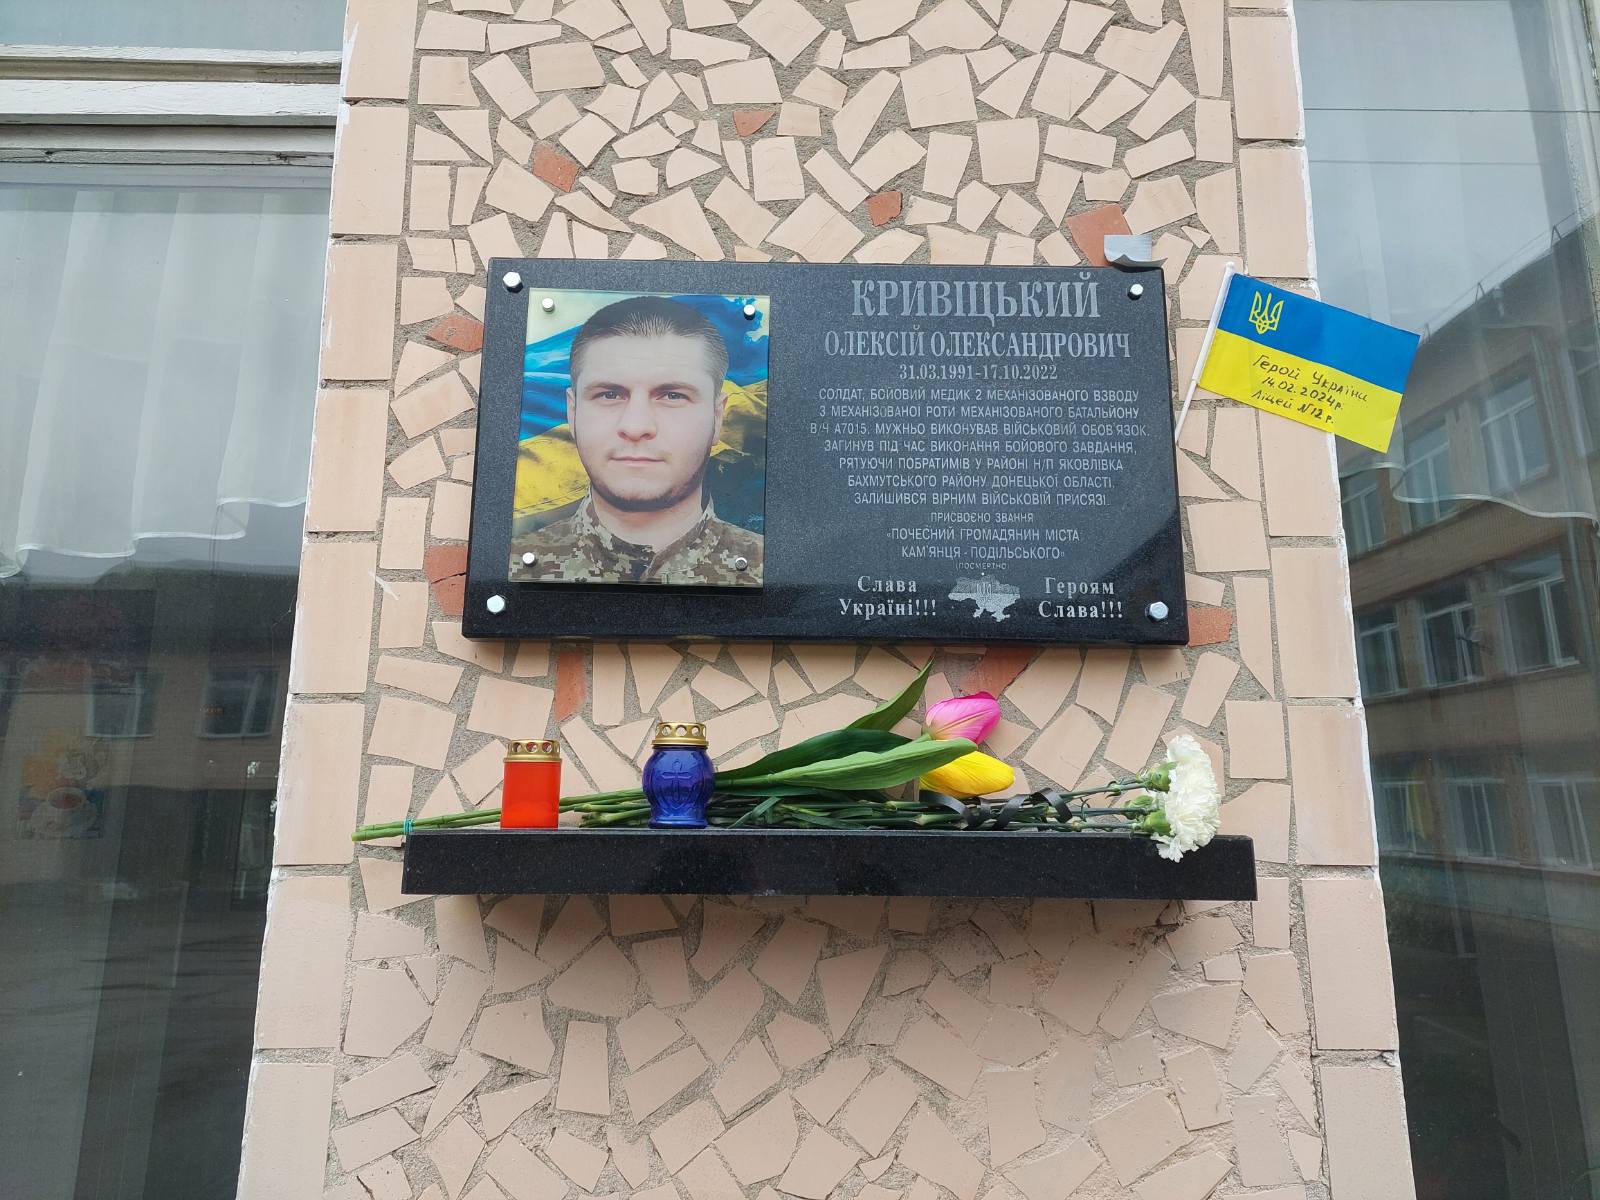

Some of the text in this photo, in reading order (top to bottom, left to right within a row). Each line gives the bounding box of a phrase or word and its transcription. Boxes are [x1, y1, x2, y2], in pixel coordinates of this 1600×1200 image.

[851, 272, 1100, 327] КРИВІЦЬКИЙ
[824, 325, 1131, 361] ОЛЕКСІЙ ОЛЕКСАНДРОВИЧ
[899, 364, 1058, 380] 31.03.1991-17.10.2022
[870, 387, 925, 401] БОЙОВИЙ
[931, 389, 970, 402] МЕДИК
[976, 390, 982, 400] 2
[987, 389, 1088, 401] МЕХАНІЗОВАНОГО
[1093, 390, 1138, 403] ВЗВОДУ
[926, 406, 955, 418] РОТИ
[961, 406, 1062, 418] МЕХАНІЗОВАНОГО
[1068, 404, 1139, 419] БАТАЛЬЙОНУ
[810, 423, 829, 434] В/Ч
[875, 423, 925, 435] МУЖНЬО
[930, 423, 998, 435] ВИКОНУВАВ
[1004, 421, 1076, 435] ВІЙСЬКОВИЙ
[824, 440, 874, 452] ЗАГИНУВ
[879, 440, 898, 453] ПІД
[904, 440, 925, 452] ЧАС
[930, 440, 1000, 452] ВИКОНАННЯ
[1005, 438, 1067, 452] БОЙОВОГО
[840, 456, 1123, 470] РЯТУЮЧИ ПОБРАТИМІВ У РАЙОНІ Н/П ЯКОВЛІВКА
[848, 475, 937, 487] БАХМУТСЬКОГО
[942, 473, 987, 487] РАЙОНУ
[992, 474, 1058, 489] ДОНЕЦЬКОЇ
[854, 492, 927, 504] ЗАЛИШИВСЯ
[932, 493, 975, 505] ВІРНИМ
[982, 490, 1051, 505] ВІЙСЬКОВІЙ
[930, 512, 1034, 523] ПРИСВОЄНО ЗВАННЯ
[960, 528, 1040, 543] ГРОМАДЯНИН
[858, 576, 917, 593] Слава
[1044, 577, 1115, 598] Героям
[839, 598, 937, 620] Україні!!!
[1039, 601, 1123, 618] Слава!!!
